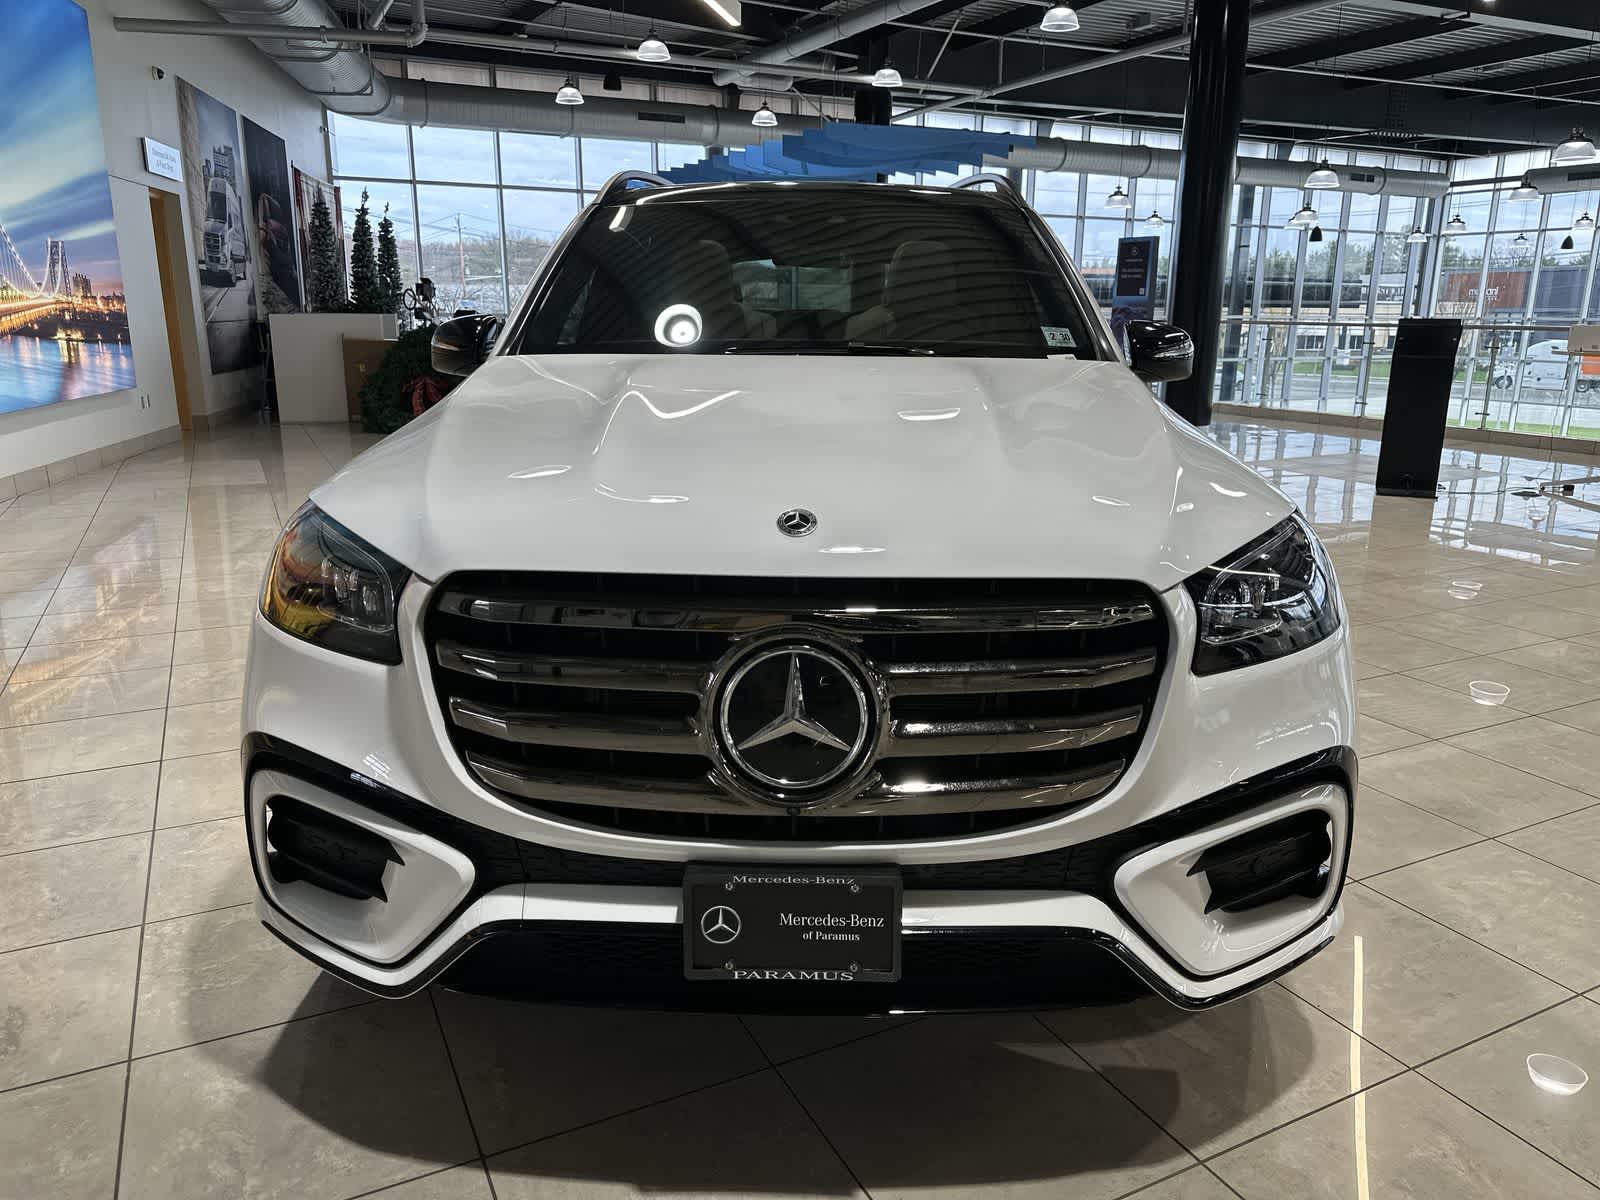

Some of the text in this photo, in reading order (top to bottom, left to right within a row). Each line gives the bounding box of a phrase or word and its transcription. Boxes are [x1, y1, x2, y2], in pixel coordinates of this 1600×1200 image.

[733, 875, 855, 885] Mercedes-Benz
[779, 913, 885, 928] Mercedes-Benz
[802, 931, 860, 942] of Paramus
[733, 970, 854, 981] PARAMUS
